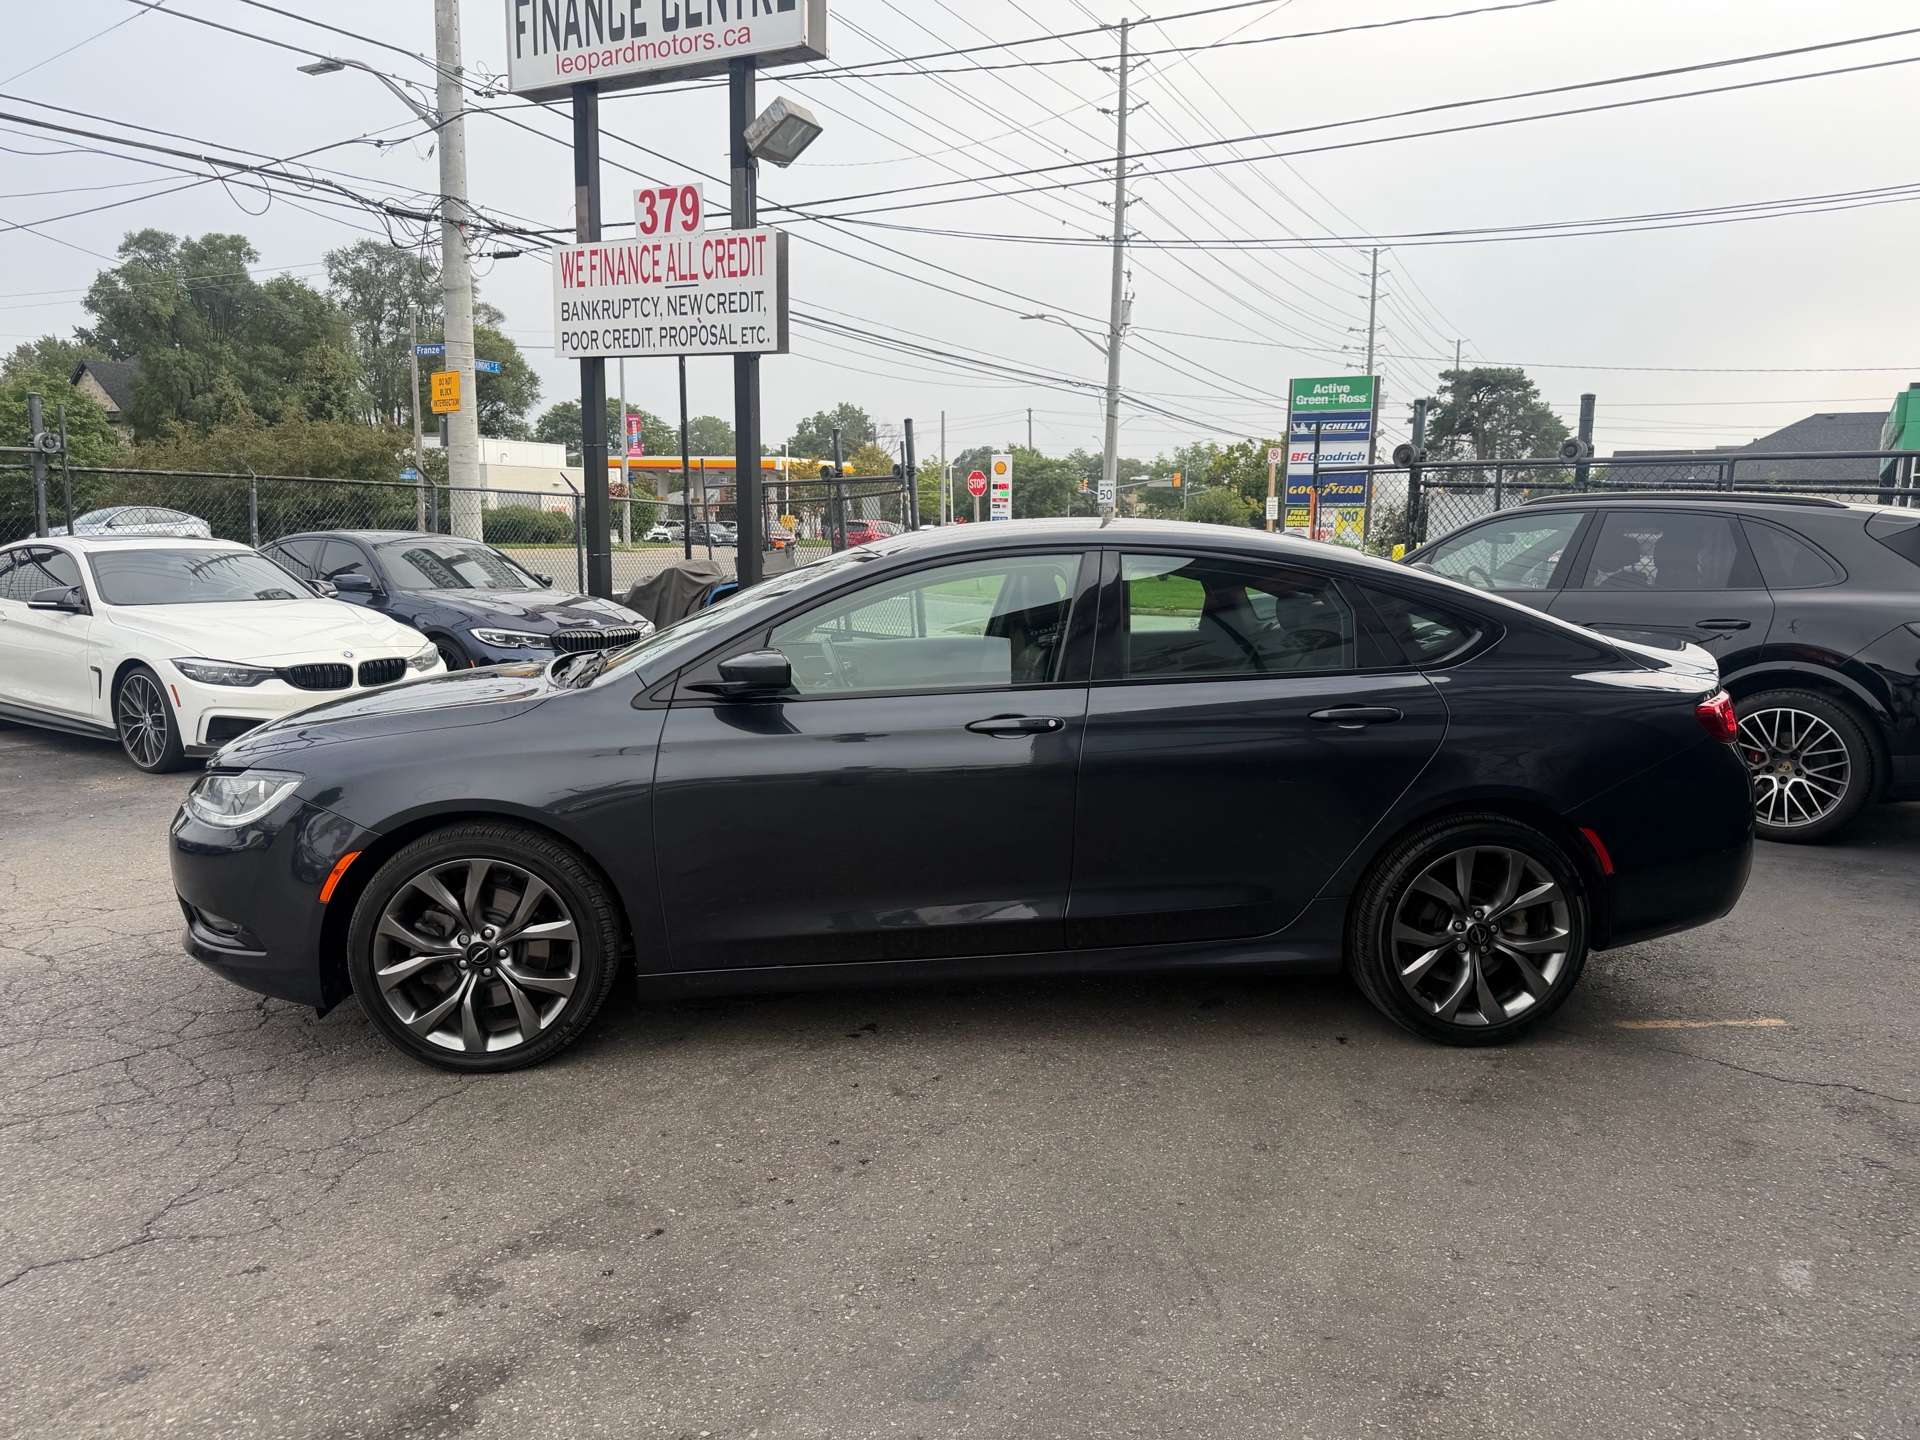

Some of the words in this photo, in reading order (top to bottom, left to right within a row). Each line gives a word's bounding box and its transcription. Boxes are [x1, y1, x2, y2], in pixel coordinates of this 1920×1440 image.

[556, 26, 751, 74] leopardmotors.ca
[639, 185, 700, 235] 379
[560, 250, 585, 288] WE
[590, 244, 662, 287] FINANCE
[666, 241, 698, 282] ALL
[702, 235, 767, 280] CREDIT
[561, 296, 662, 322] BANKRUPTCY,
[667, 294, 703, 316] NEW
[705, 291, 767, 315] CREDIT,
[561, 331, 599, 350] POOR
[602, 327, 656, 349] CREDIT,
[659, 324, 738, 347] PROPOSAL
[741, 326, 770, 344] ETC.
[1313, 384, 1350, 394] Active
[969, 478, 985, 488] STOP
[1099, 490, 1112, 500] 50
